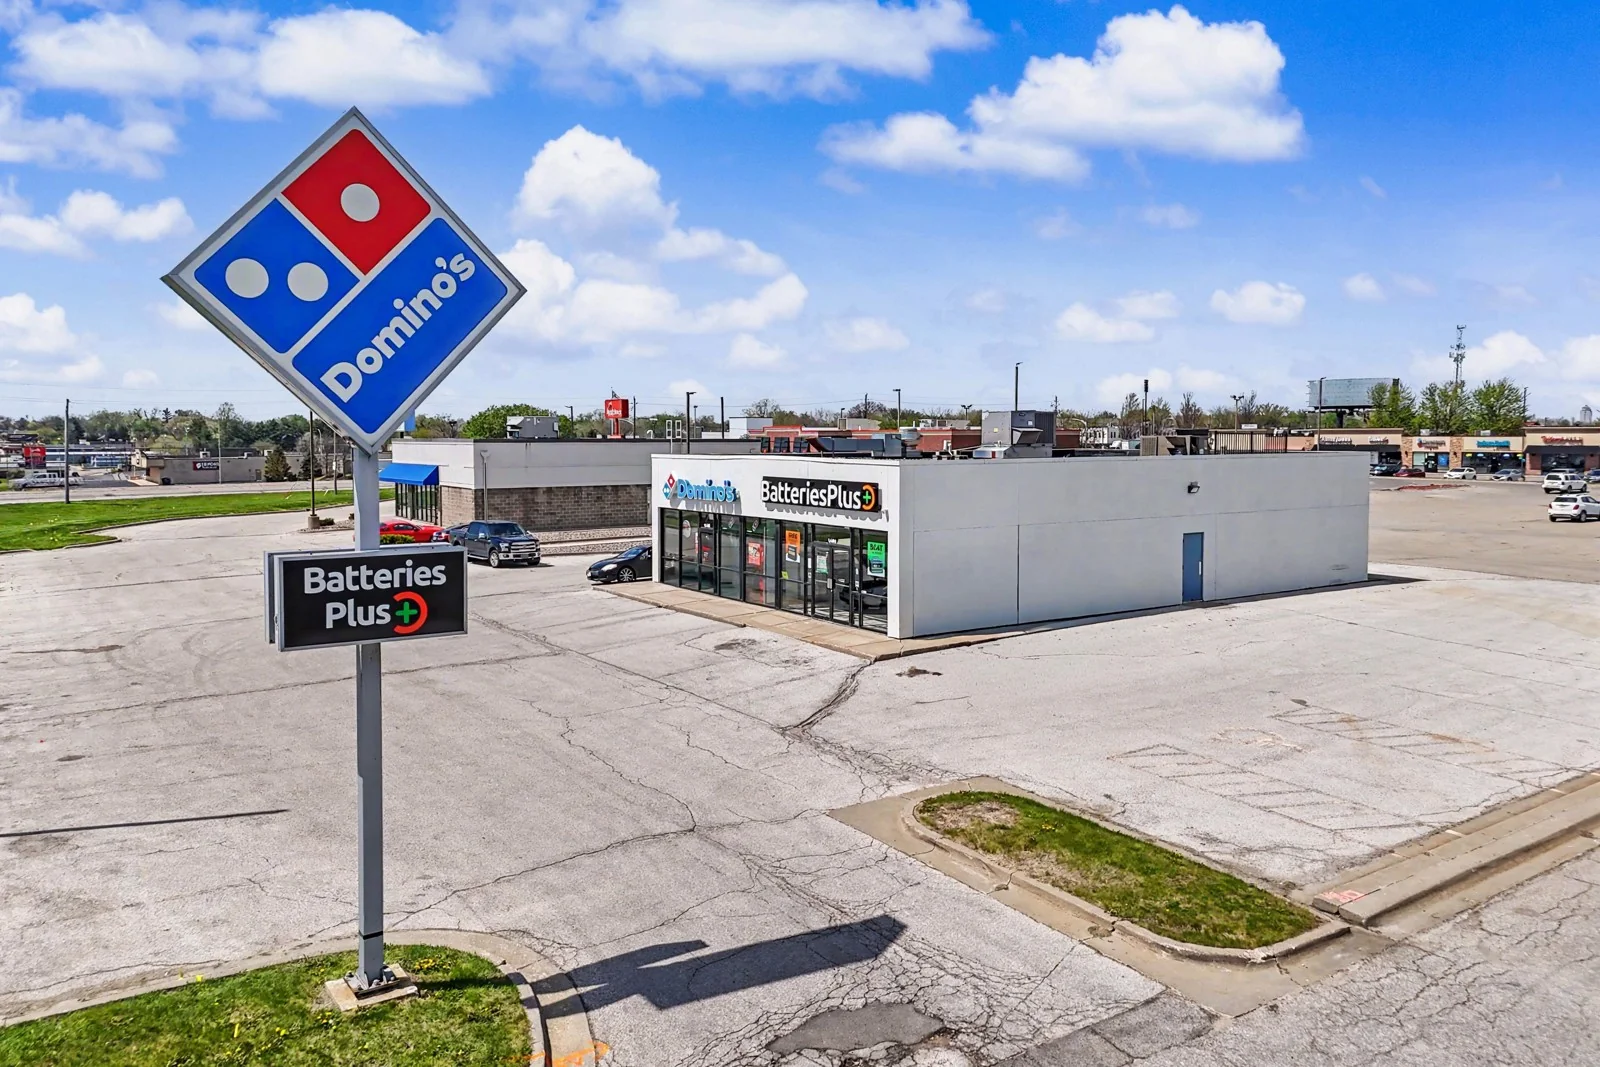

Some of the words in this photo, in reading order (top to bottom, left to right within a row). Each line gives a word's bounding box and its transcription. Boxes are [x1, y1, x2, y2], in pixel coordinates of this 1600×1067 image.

[320, 252, 476, 403] Domino's
[677, 479, 736, 502] Domino's
[304, 559, 447, 594] Batteries
[326, 598, 392, 629] Plus
